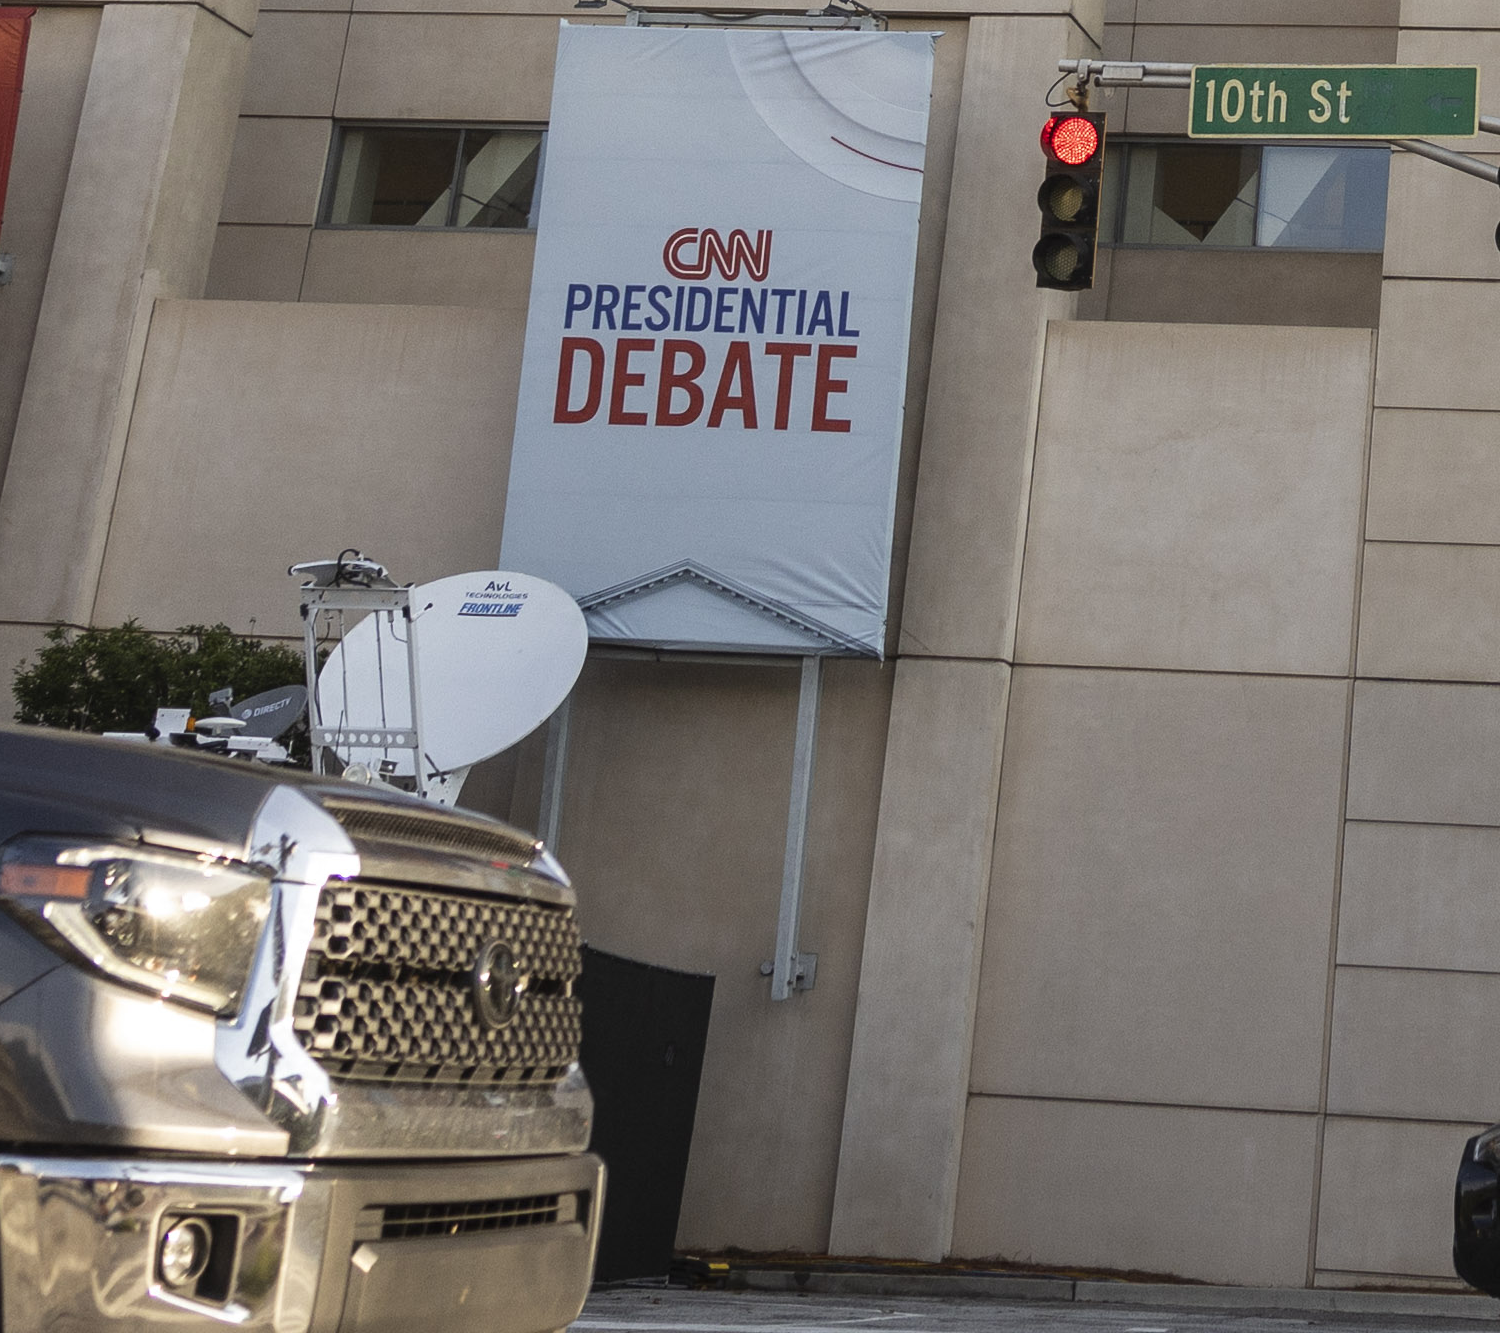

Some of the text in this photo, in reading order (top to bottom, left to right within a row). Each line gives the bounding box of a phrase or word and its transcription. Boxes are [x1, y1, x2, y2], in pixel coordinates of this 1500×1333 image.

[1206, 79, 1287, 123] 10th
[1308, 79, 1352, 123] St
[663, 227, 772, 282] CNN
[563, 283, 860, 338] PRESIDENTIAL
[553, 337, 858, 433] DEBATE
[459, 602, 524, 615] FRONTLINE
[253, 696, 292, 718] DIRECTV
